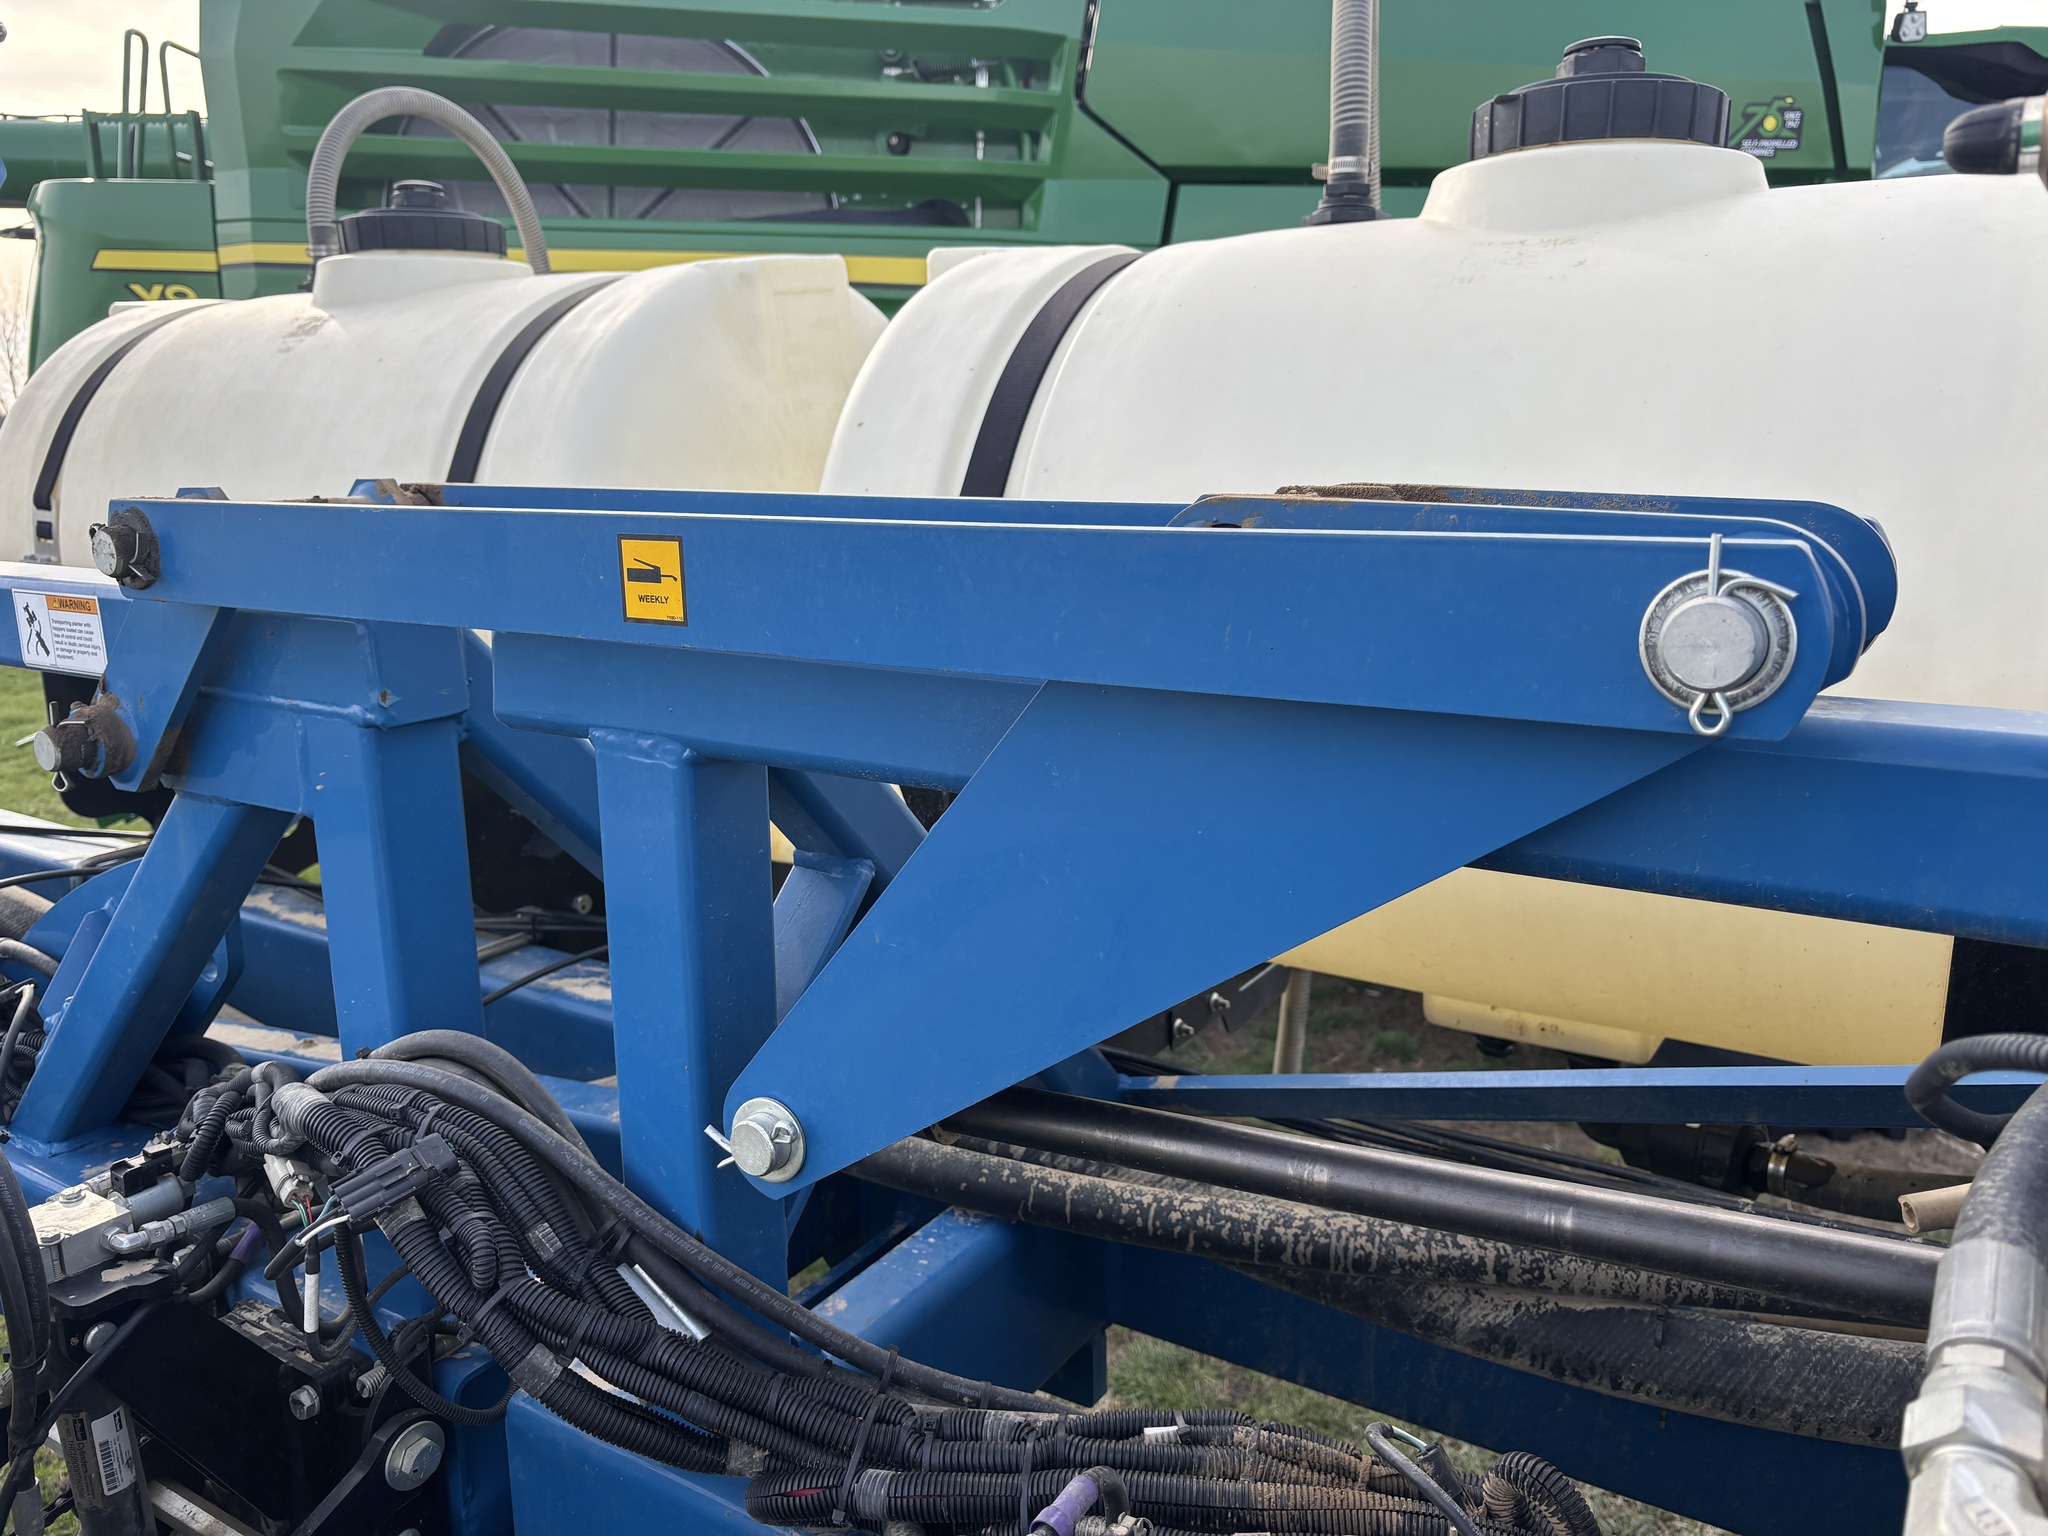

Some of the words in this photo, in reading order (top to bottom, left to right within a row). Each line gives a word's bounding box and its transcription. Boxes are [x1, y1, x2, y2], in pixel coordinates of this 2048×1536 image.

[58, 598, 91, 611] WARNING
[638, 594, 669, 604] WEEKLY
[51, 619, 72, 627] Transporting
[942, 1380, 982, 1398] Continental
[77, 1443, 88, 1473] Cylinders
